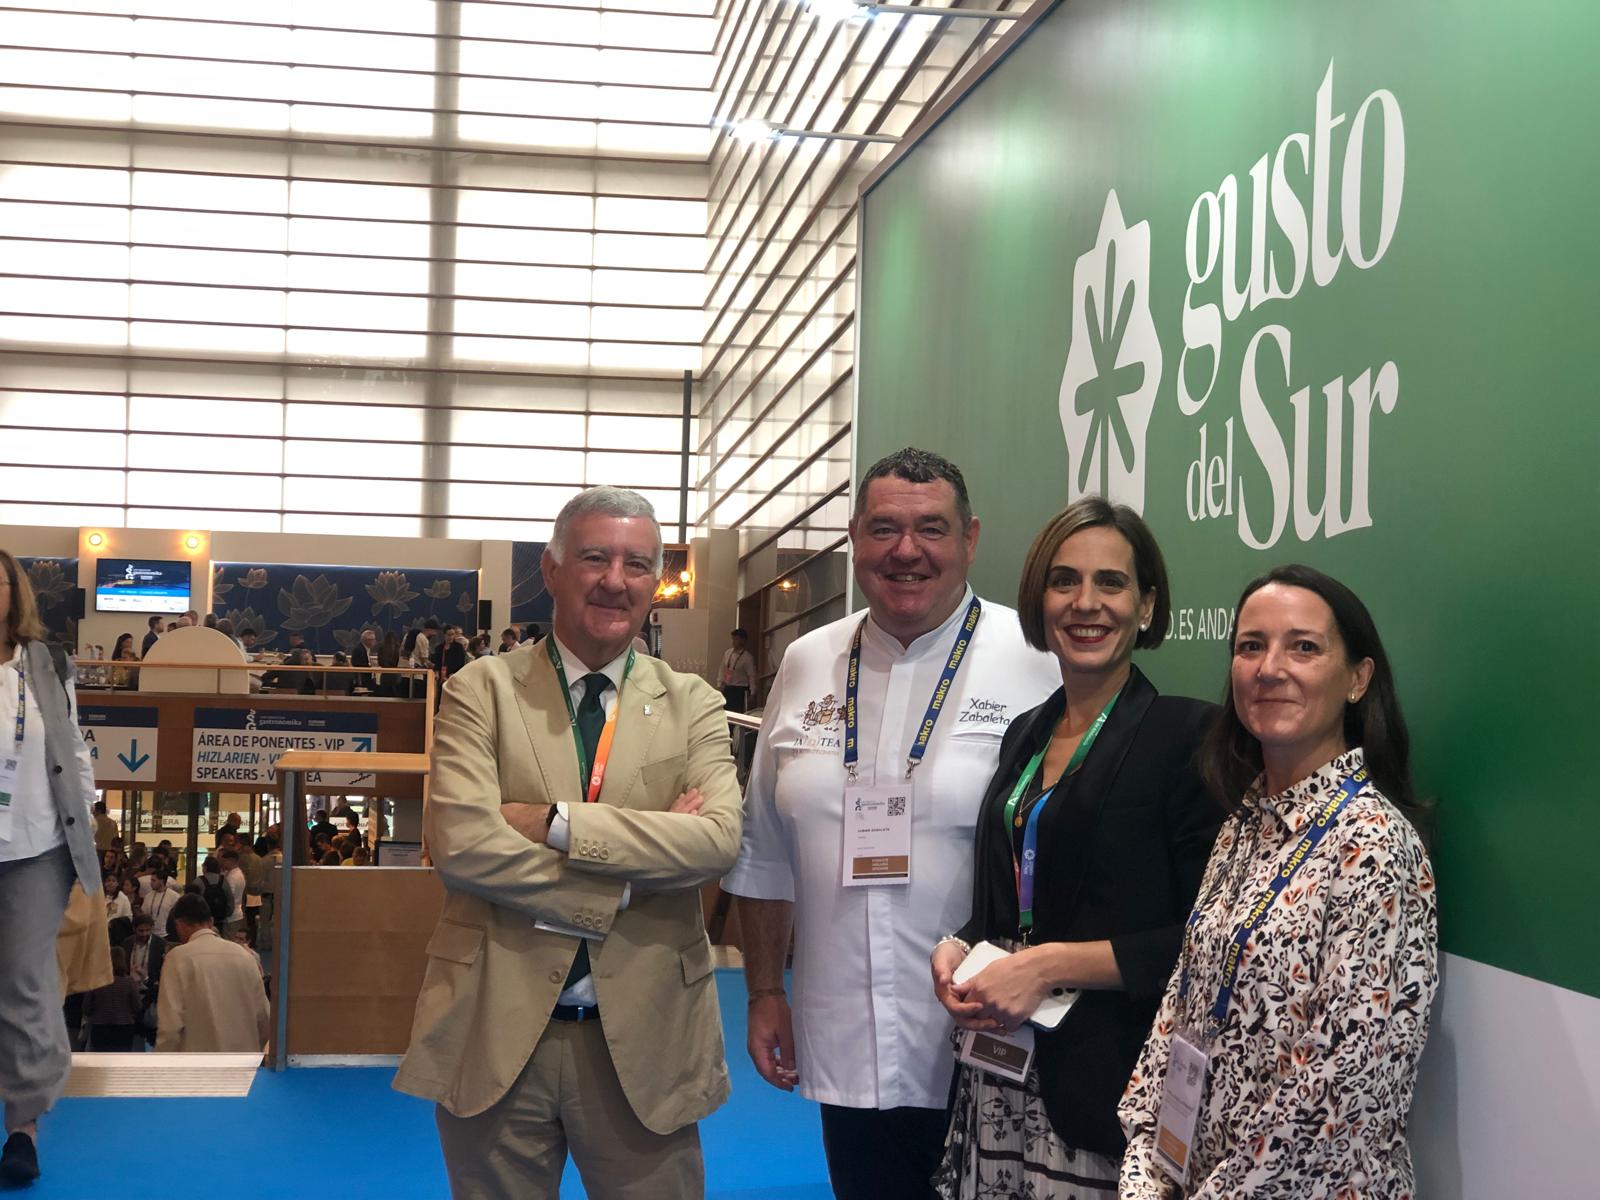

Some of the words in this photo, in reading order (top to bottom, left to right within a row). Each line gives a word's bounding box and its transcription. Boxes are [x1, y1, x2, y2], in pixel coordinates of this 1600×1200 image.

[1177, 56, 1405, 416] gusto
[1186, 416, 1233, 522] del
[1238, 324, 1399, 550] Sur
[966, 606, 980, 632] makro
[1197, 607, 1235, 640] ANDA
[949, 639, 966, 669] makro
[849, 657, 857, 688] makro
[932, 678, 950, 710] makro
[969, 697, 1007, 712] Xabier
[847, 696, 856, 728] makro
[959, 711, 1010, 725] Zabaleta
[197, 731, 230, 747] ÁREA
[233, 735, 248, 747] DE
[251, 736, 316, 750] PONENTES
[324, 738, 345, 751] VIP
[196, 767, 258, 781] SPEAKERS
[197, 751, 260, 765] HIZLARIEN
[1317, 789, 1348, 827] makro
[1282, 839, 1312, 878] makro
[1244, 890, 1275, 929] makro
[1223, 942, 1241, 987] makro
